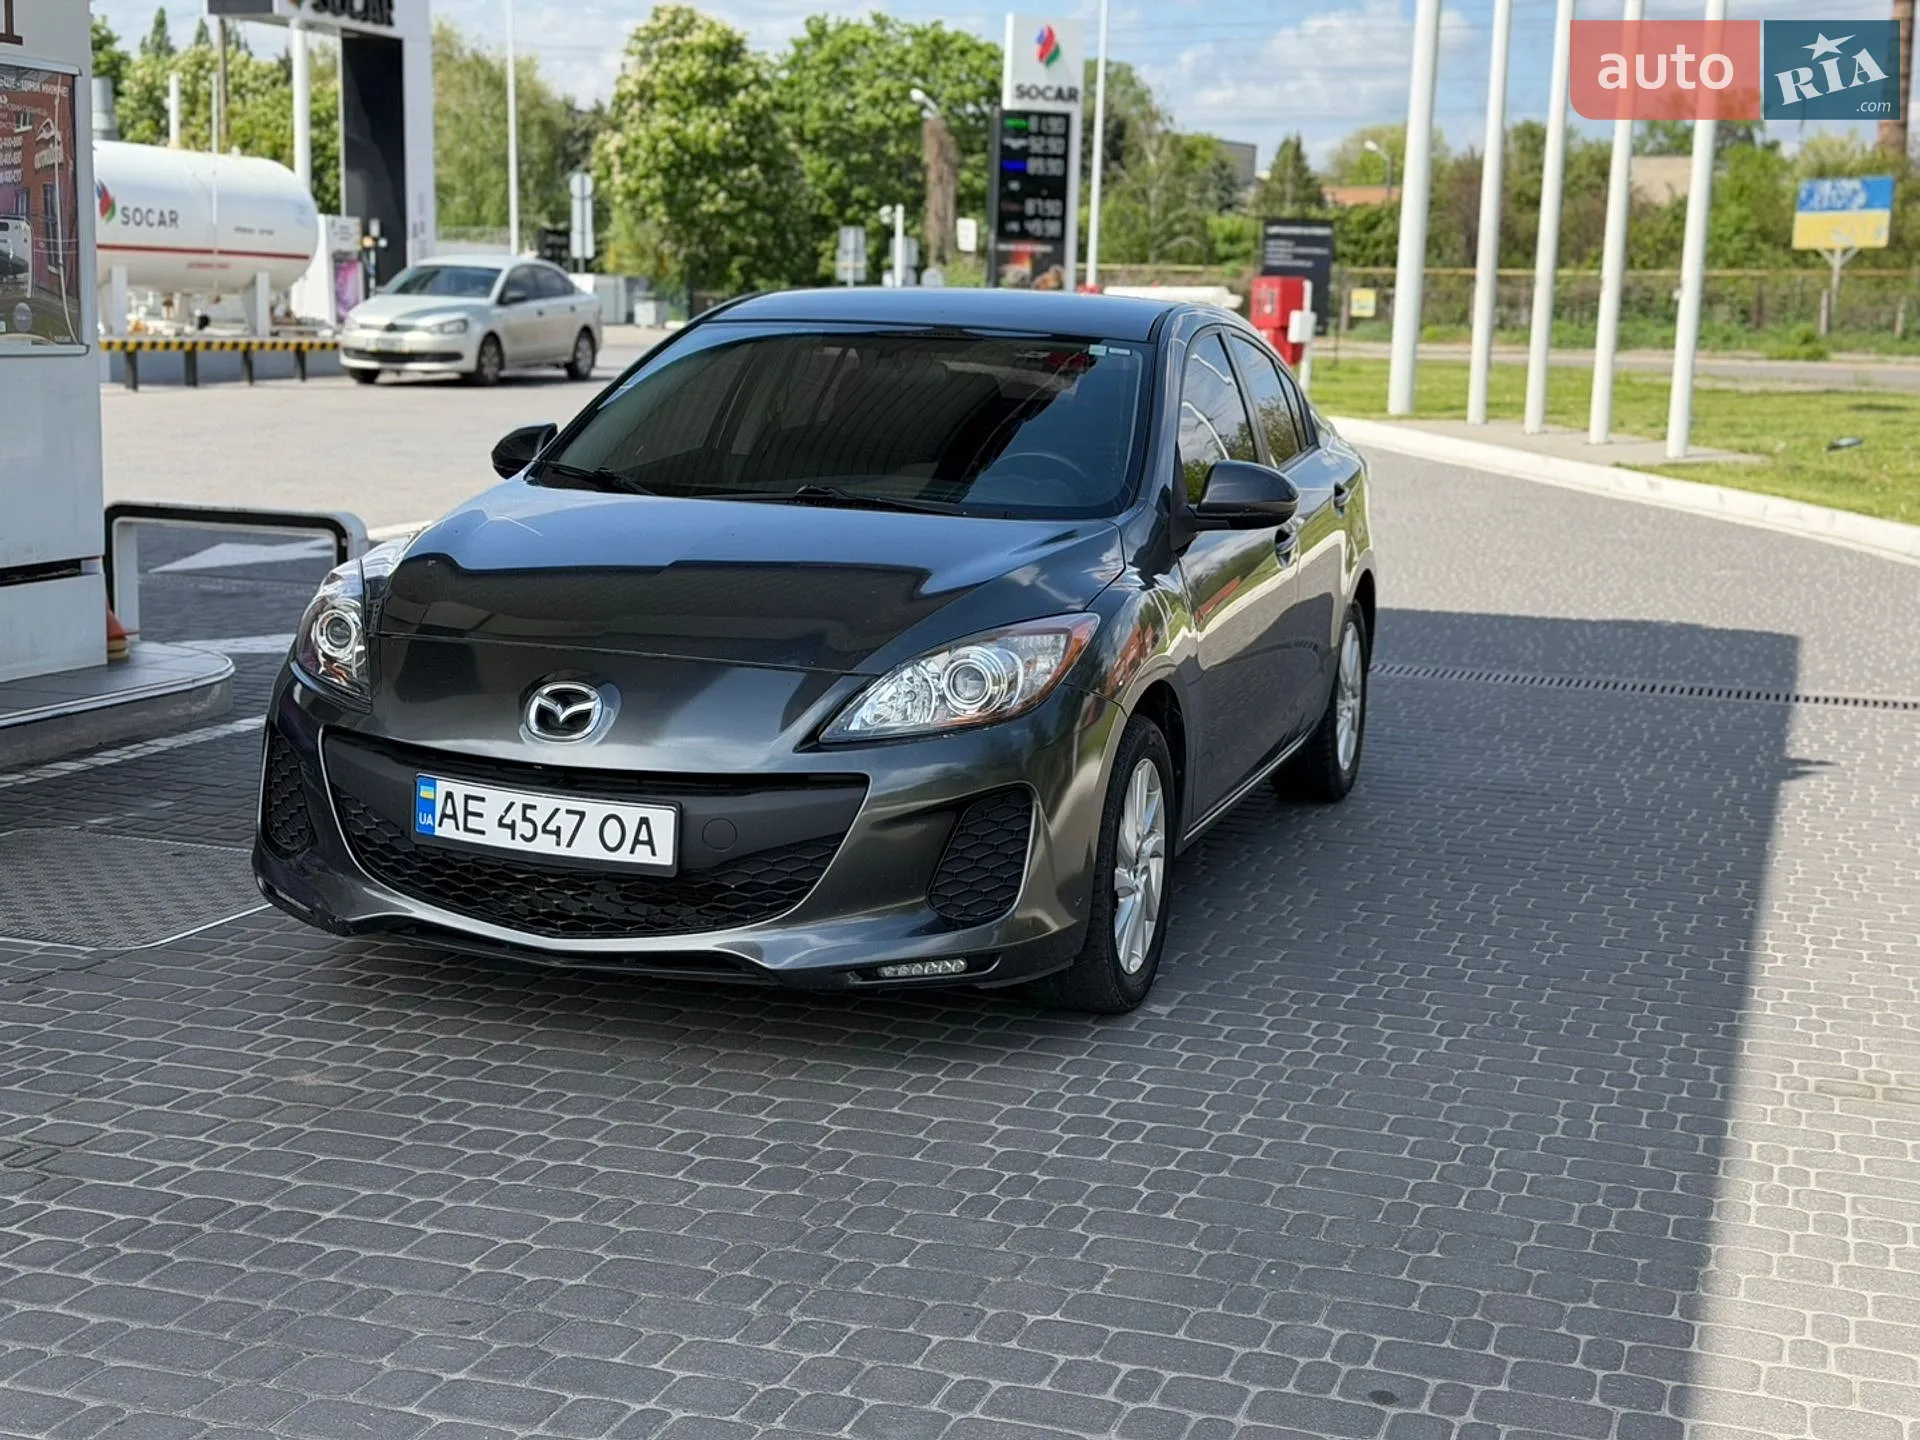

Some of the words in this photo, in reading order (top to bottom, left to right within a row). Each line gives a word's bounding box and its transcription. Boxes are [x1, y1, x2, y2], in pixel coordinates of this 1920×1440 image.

[1015, 84, 1079, 103] SOCAR
[120, 206, 179, 228] SOCAR
[419, 811, 435, 826] UA
[437, 791, 486, 836] AE
[497, 801, 586, 848] 4547
[598, 813, 657, 857] OA
